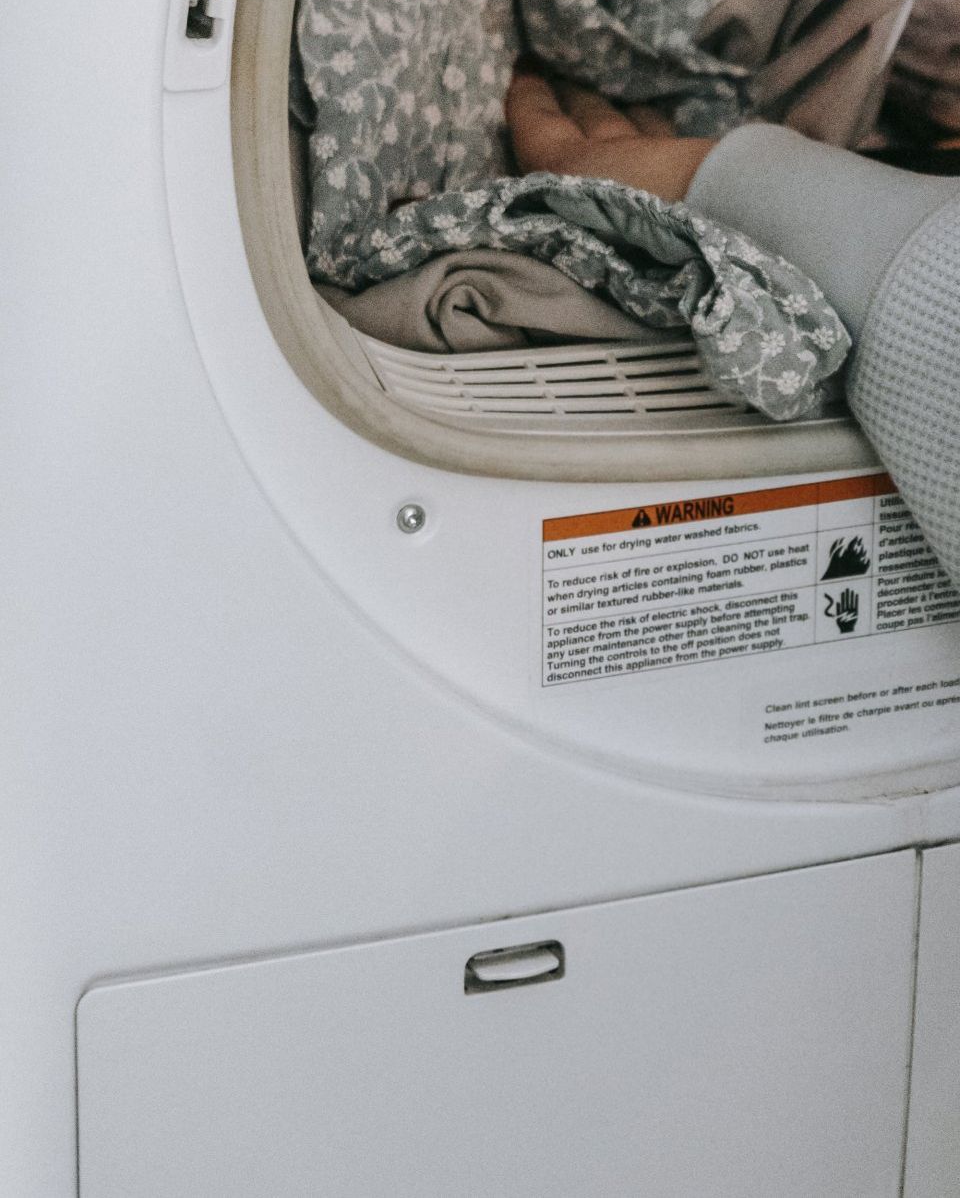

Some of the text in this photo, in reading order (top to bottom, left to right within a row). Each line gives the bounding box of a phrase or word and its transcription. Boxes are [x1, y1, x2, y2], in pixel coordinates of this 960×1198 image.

[655, 496, 734, 525] WARNING
[547, 547, 575, 559] ONLY
[581, 545, 599, 554] use
[602, 542, 616, 551] for
[619, 538, 651, 550] drying
[654, 534, 681, 544] water
[683, 526, 721, 540] washed
[547, 579, 559, 588] To
[562, 575, 596, 586] reduce
[599, 571, 618, 581] risk
[621, 568, 631, 578] of
[633, 567, 650, 576] fire
[652, 565, 663, 574] or
[722, 552, 738, 564] DO
[743, 548, 764, 560] NOT
[767, 548, 785, 557] use
[787, 543, 809, 554] heat
[547, 592, 574, 602] when
[576, 586, 609, 599] drying
[611, 581, 648, 593] articles
[651, 573, 703, 587] containing
[706, 569, 731, 578] foam
[770, 558, 807, 571] plastics
[547, 607, 557, 616] or
[560, 602, 594, 614] similar
[597, 594, 638, 608] textured
[547, 627, 560, 636] To
[562, 623, 597, 634] reduce
[599, 620, 615, 629] the
[618, 616, 636, 626] risk
[639, 612, 649, 623] of
[651, 609, 687, 621] electric
[724, 594, 777, 610] disconnect
[780, 592, 798, 601] this
[546, 650, 564, 660] any
[568, 646, 590, 656] user
[592, 636, 656, 652] maintenance
[658, 632, 684, 642] other
[686, 628, 708, 638] than
[710, 622, 751, 634] cleaning
[754, 618, 769, 627] the
[771, 615, 787, 624] lint
[547, 604, 795, 649] appliance from the power supply before attempting
[546, 665, 601, 682] disconnect
[604, 663, 623, 673] this
[625, 656, 672, 671] appliance
[675, 652, 698, 661] from
[700, 649, 716, 658] the
[718, 644, 748, 657] power
[547, 627, 780, 670] Turning the controls to the off position does not
[764, 719, 805, 730] Nettoyer
[807, 716, 816, 724] le
[818, 713, 840, 722] filtre
[842, 711, 854, 719] de
[856, 706, 891, 717] charpie
[893, 701, 919, 712] avant
[765, 703, 792, 713] Clean
[794, 700, 810, 708] lint
[812, 696, 844, 706] screen
[847, 691, 877, 702] before
[891, 685, 912, 695] after
[915, 681, 937, 692] each
[763, 732, 799, 743] chaque
